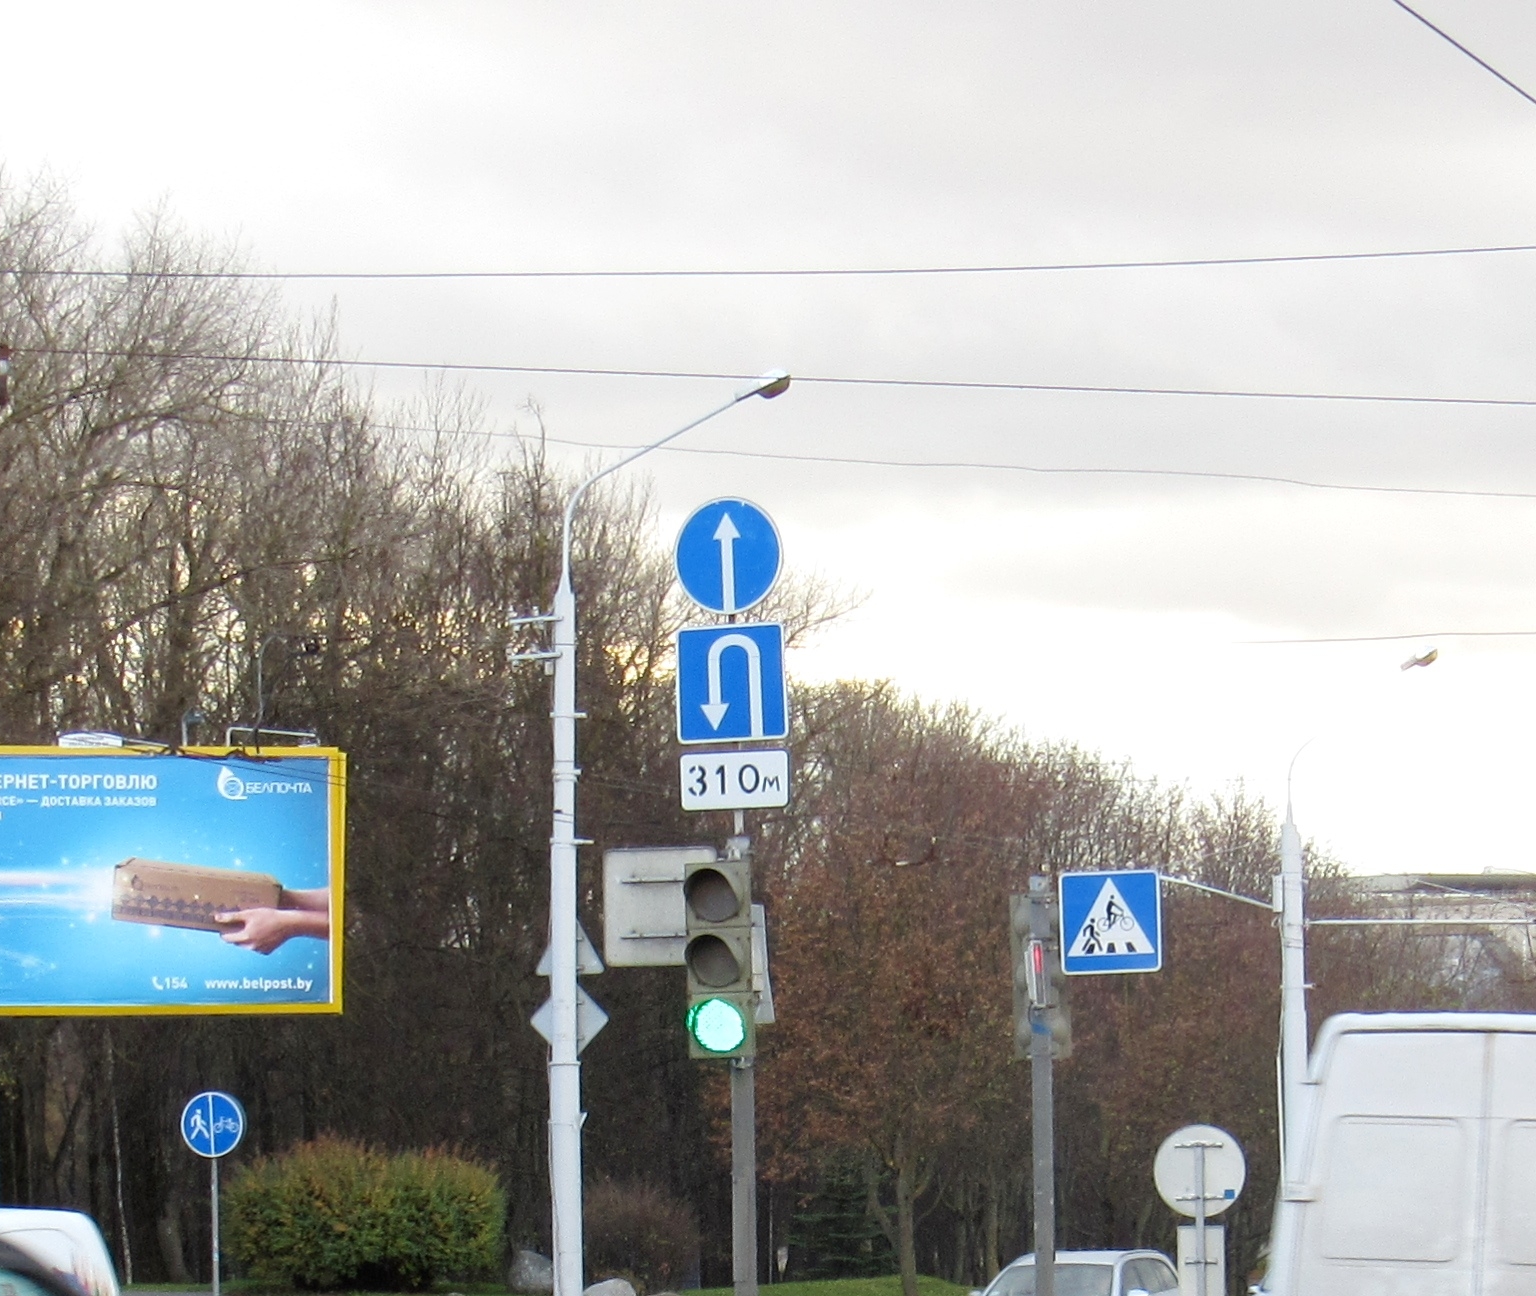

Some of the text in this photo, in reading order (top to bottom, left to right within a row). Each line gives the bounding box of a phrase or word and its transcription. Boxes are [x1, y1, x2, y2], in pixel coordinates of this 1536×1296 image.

[246, 781, 313, 794] БЕЛПОЧТА
[40, 796, 102, 808] ДОСТАВКА
[104, 796, 157, 807] ЗАКАЗОВ
[164, 976, 313, 992] 154 www.belpost.by
